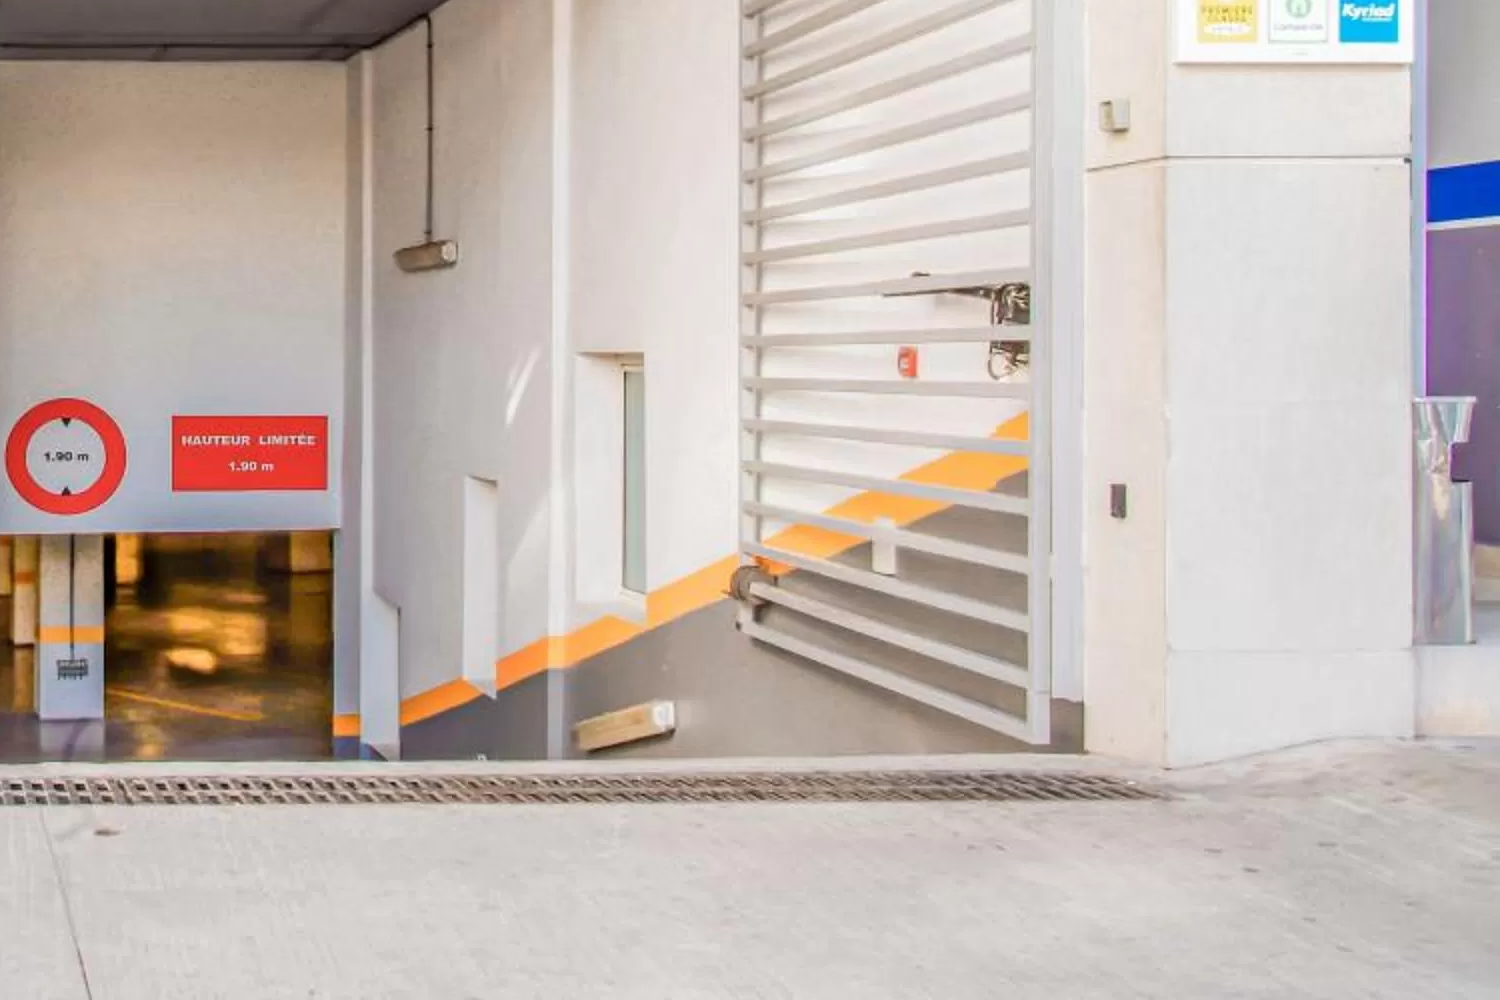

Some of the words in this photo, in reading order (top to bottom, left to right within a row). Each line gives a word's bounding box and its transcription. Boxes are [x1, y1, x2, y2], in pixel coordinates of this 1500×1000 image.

[1341, 2, 1396, 21] Kyriad
[181, 435, 251, 446] HAUTEUR
[259, 433, 316, 446] LIMITÉE
[43, 451, 73, 462] 1.90
[77, 453, 89, 462] m
[228, 461, 257, 472] 1.90
[261, 463, 275, 472] m
